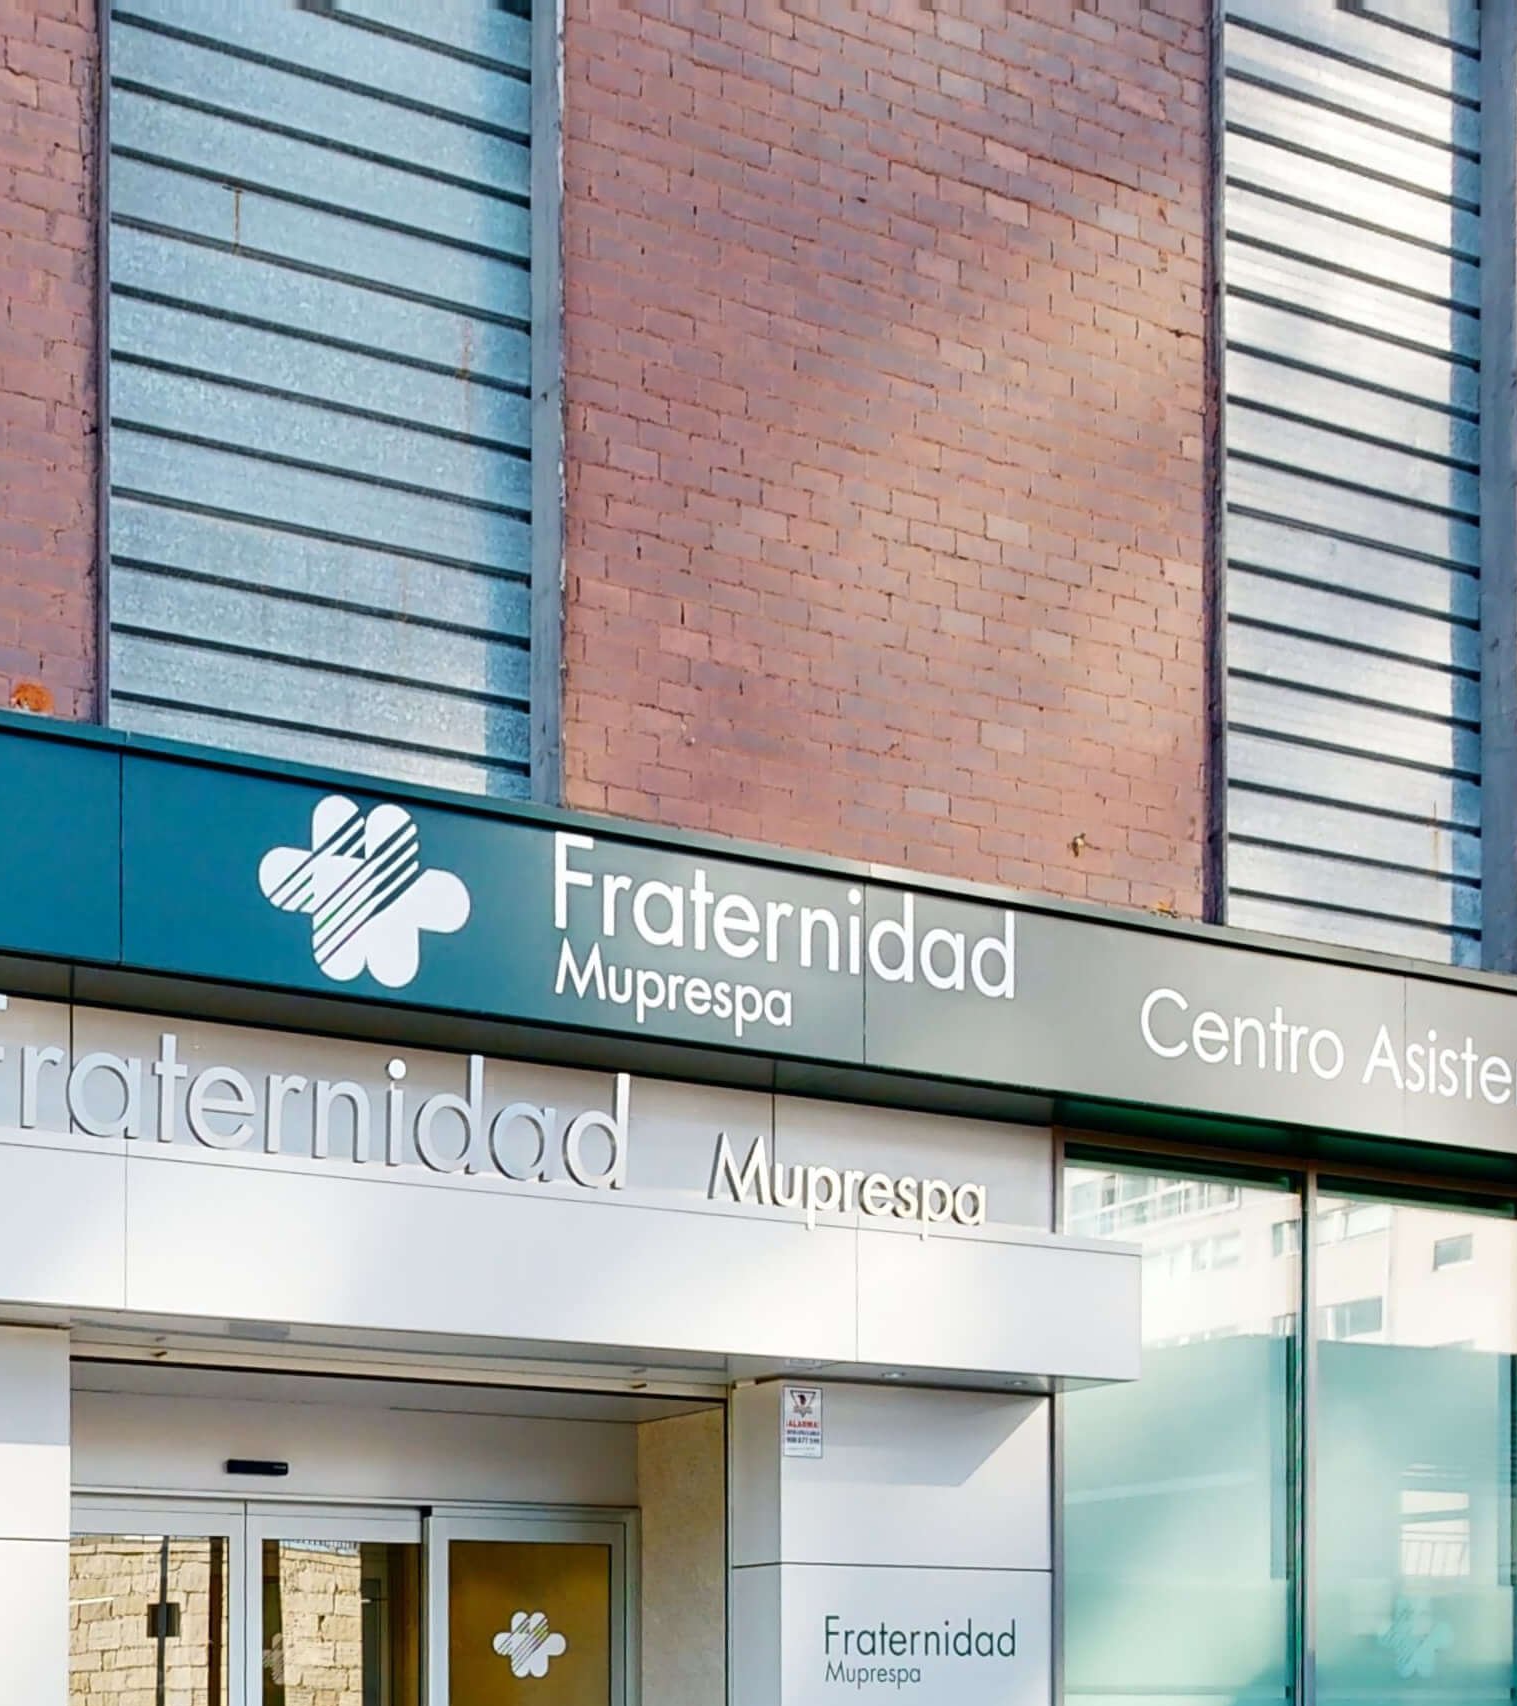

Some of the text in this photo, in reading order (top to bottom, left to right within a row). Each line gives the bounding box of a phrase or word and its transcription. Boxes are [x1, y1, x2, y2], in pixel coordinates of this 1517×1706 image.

[554, 831, 1016, 1000] Fraternidad
[554, 938, 793, 1038] Muprespa
[1139, 987, 1346, 1081] Centro
[707, 1131, 987, 1241] Muprespa
[824, 1614, 1017, 1659] Fraternidad
[824, 1660, 922, 1691] Muprespa
